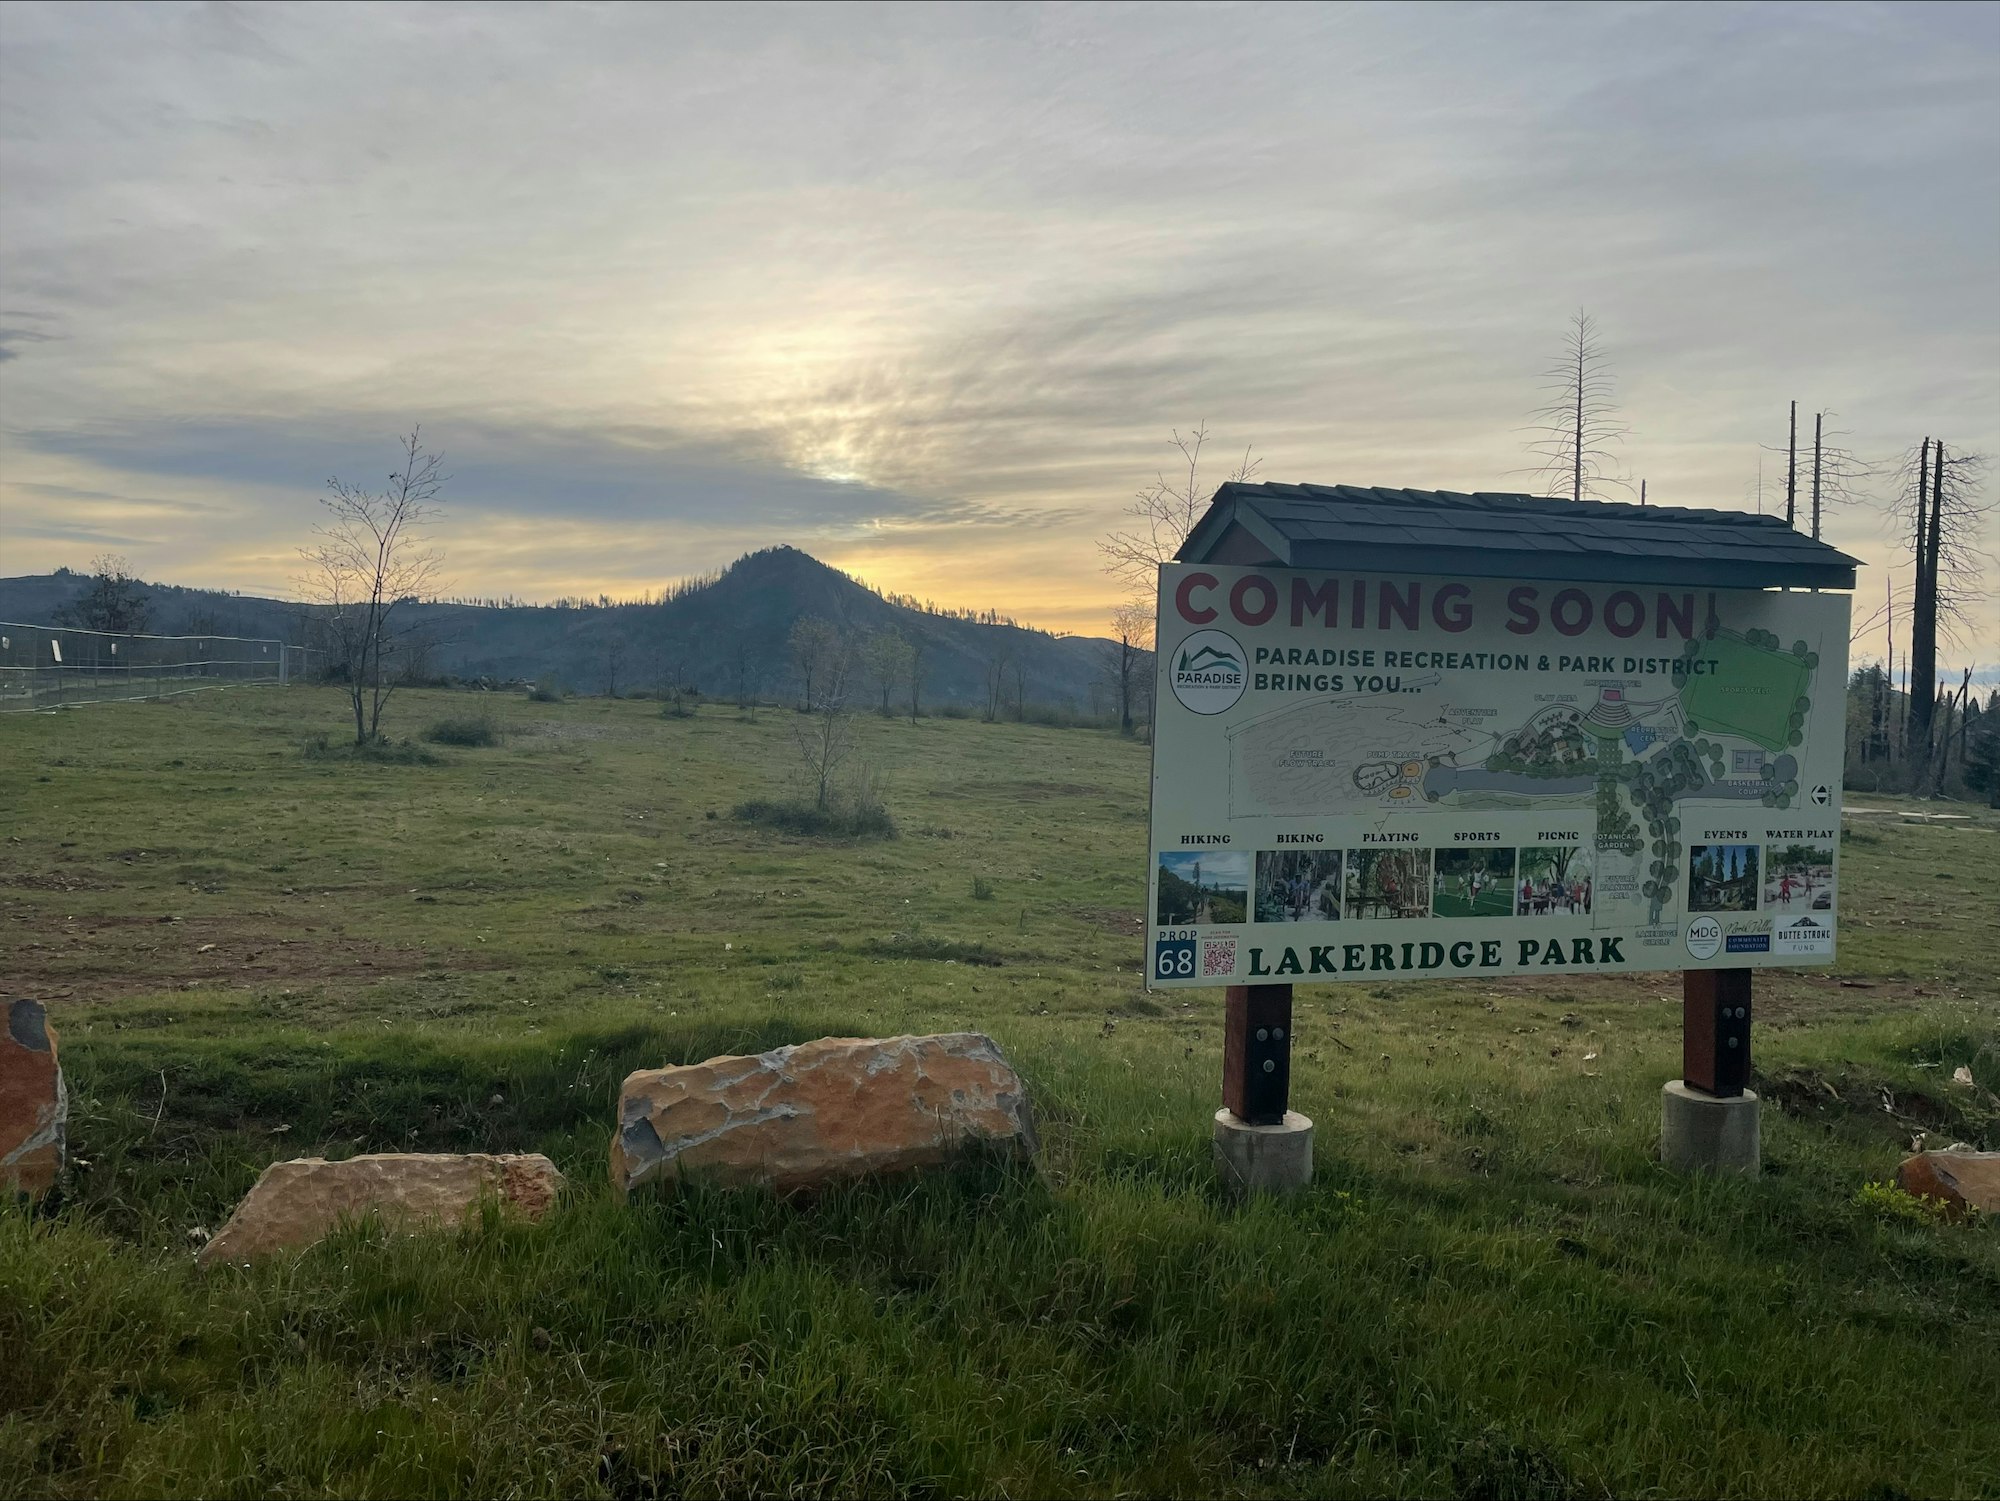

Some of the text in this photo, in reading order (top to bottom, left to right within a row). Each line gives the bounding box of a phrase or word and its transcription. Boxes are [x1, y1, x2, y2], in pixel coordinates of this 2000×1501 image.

[1175, 572, 1717, 641] COMING SOON!
[1255, 647, 1719, 676] PARADISE RECREATION & PARK DISTRICT
[1177, 672, 1242, 684] PARADISE
[1254, 673, 1422, 694] BRINGS YOU...
[1720, 687, 1774, 695] SPORTS FIELD
[1534, 694, 1555, 702] PLAY
[1448, 708, 1498, 717] ADVENTURE
[1461, 717, 1484, 725] PLAY
[1639, 734, 1670, 743] CENTER
[1290, 750, 1323, 758] FUTURE
[1367, 751, 1421, 760] PUMP TRACK
[1279, 759, 1336, 768] FLOW TRACK
[1738, 788, 1763, 796] COURT
[1277, 833, 1324, 843] BIKING
[1363, 832, 1419, 842] PLAYING
[1454, 832, 1500, 842] SPORTS
[1538, 831, 1579, 840] PICNIC
[1593, 833, 1636, 841] BOTANICAL
[1704, 830, 1748, 839] EVENTS
[1766, 829, 1834, 839] WATER PLAY
[1181, 835, 1231, 844] HIKING
[1598, 841, 1630, 849] GARDEN
[1600, 883, 1639, 891] PLANNING
[1159, 930, 1197, 941] PROP
[1690, 926, 1719, 939] MDG
[1778, 929, 1831, 940] BUTTE STRONG
[1249, 937, 1625, 976] LAKERIDGE PARK
[1158, 949, 1193, 975] 68
